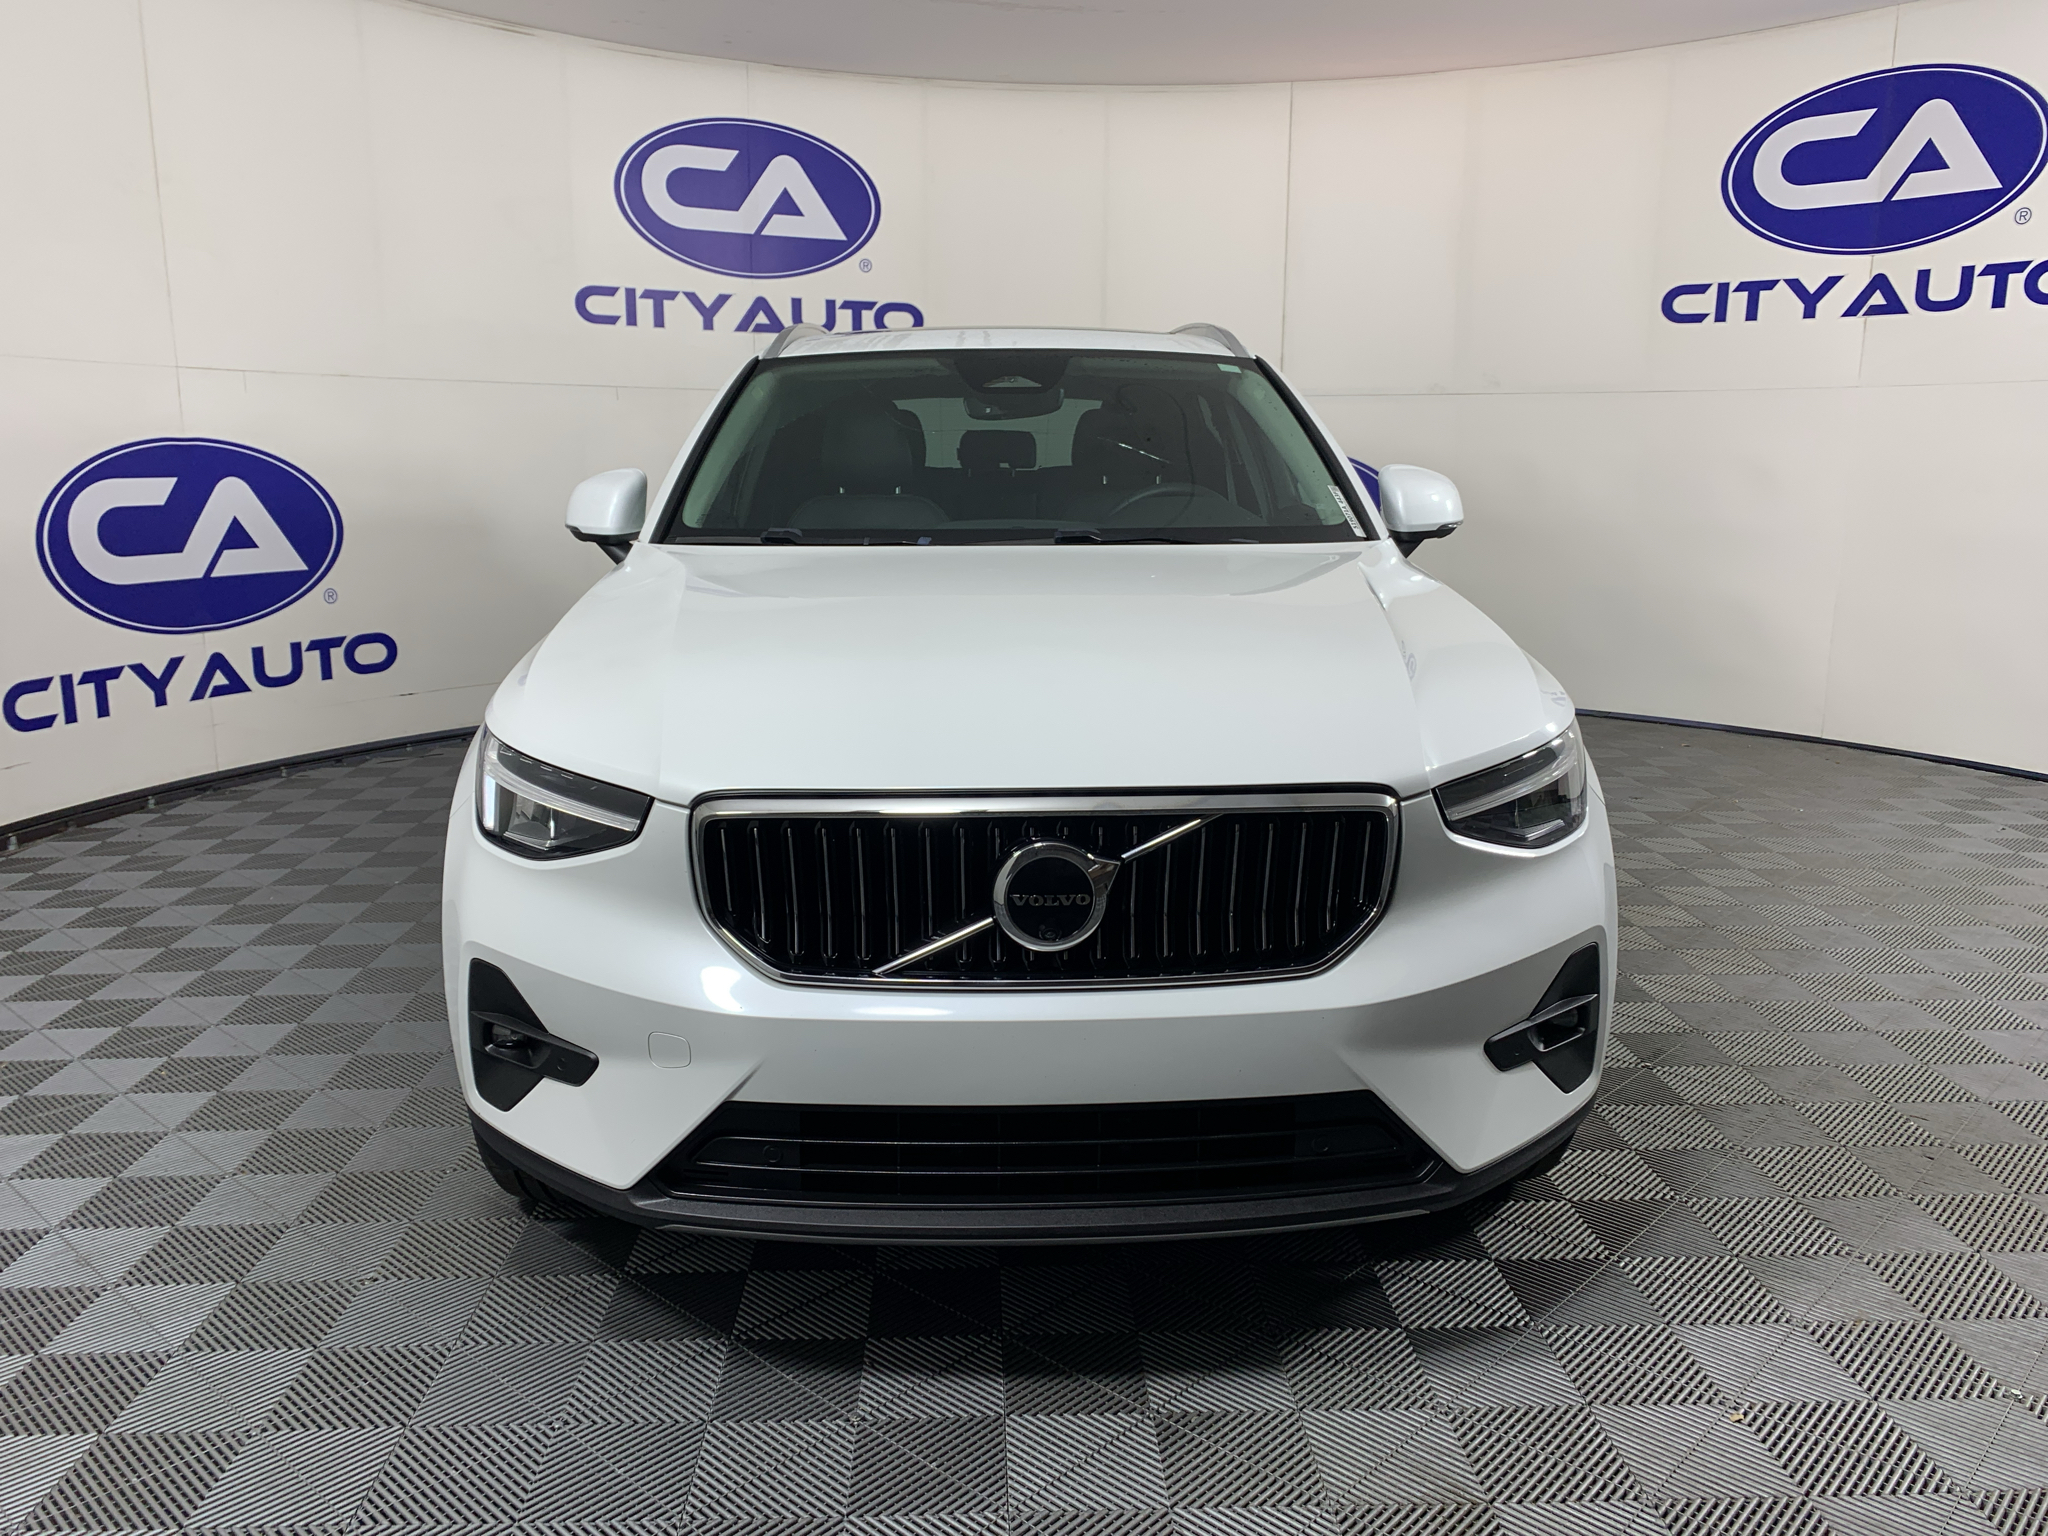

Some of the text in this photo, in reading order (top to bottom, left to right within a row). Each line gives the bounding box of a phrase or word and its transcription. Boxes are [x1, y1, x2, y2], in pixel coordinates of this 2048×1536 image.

[641, 144, 848, 241] CA
[1753, 98, 2003, 210] CA
[574, 284, 733, 331] CITY
[1661, 274, 1846, 324] CITY
[67, 476, 309, 585] CA
[2, 632, 398, 732] CITY AUTO
[1010, 894, 1091, 907] VOLVO
